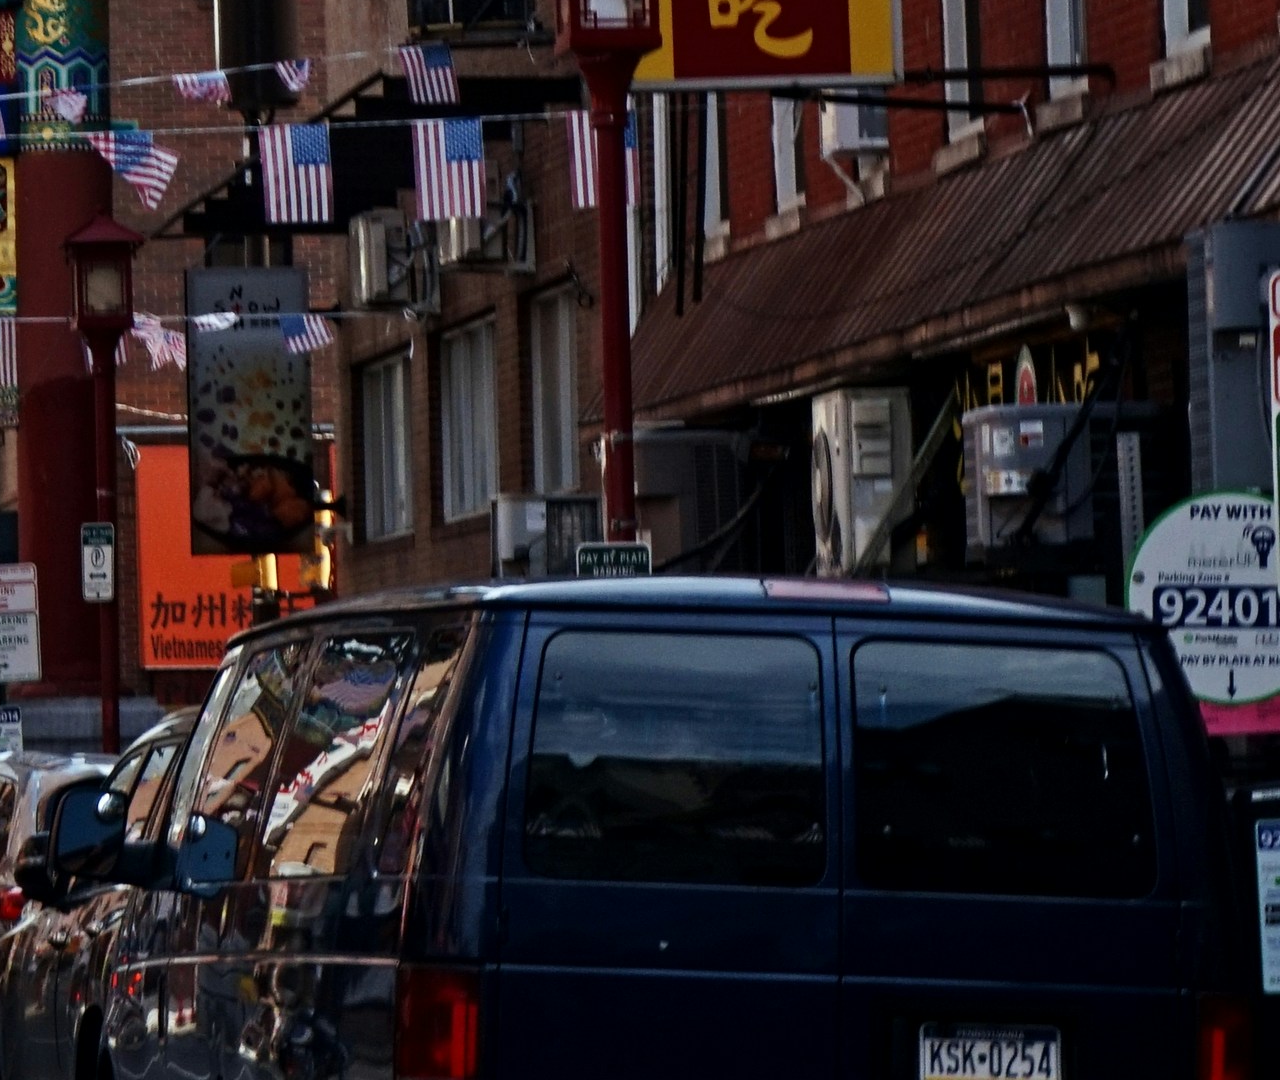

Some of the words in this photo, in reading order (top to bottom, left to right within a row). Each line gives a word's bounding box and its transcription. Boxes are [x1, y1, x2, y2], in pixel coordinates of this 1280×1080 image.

[1190, 504, 1222, 520] PAY
[1226, 504, 1271, 520] WITH
[1158, 572, 1196, 584] Parking
[1198, 573, 1222, 582] Zone
[1158, 588, 1278, 627] 92401
[150, 635, 223, 661] Vietnames
[1202, 654, 1216, 667] BY
[1219, 654, 1250, 667] PLATE
